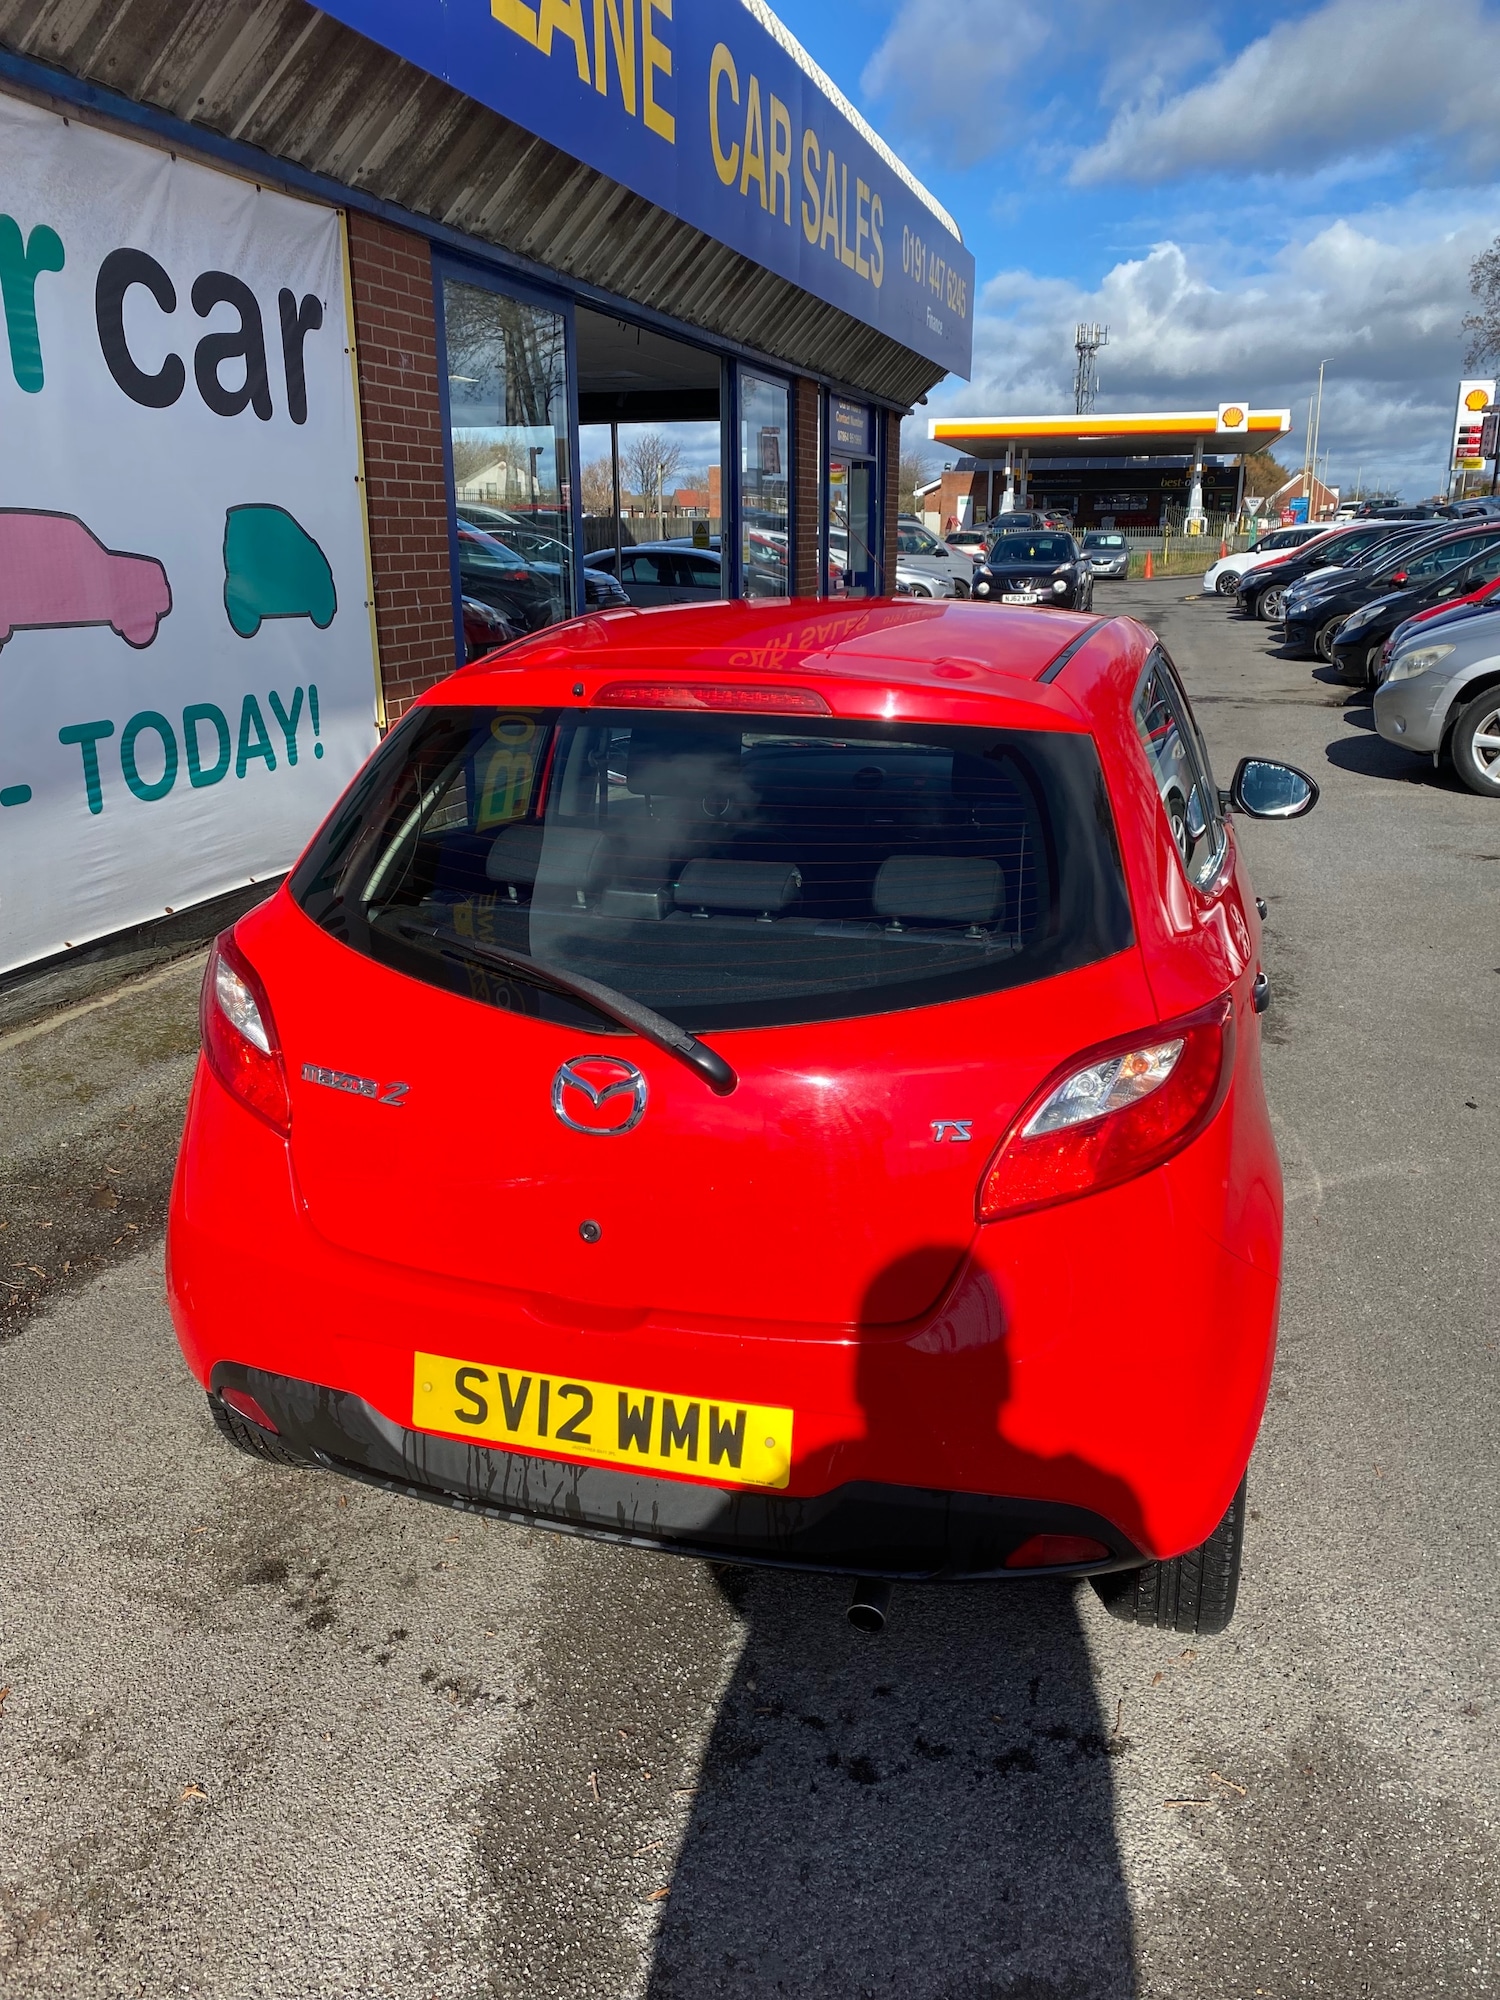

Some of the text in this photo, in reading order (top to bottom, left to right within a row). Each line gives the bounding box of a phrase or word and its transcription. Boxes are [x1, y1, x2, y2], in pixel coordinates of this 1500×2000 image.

[708, 41, 792, 227] CAR
[801, 127, 885, 289] SALES
[902, 224, 927, 288] 0191
[928, 251, 946, 301] 447
[946, 266, 967, 319] 6245
[95, 246, 324, 425] car
[926, 305, 943, 336] Finance
[1160, 477, 1204, 488] best-o
[58, 684, 325, 816] TODAY!
[378, 1080, 411, 1107] 2
[930, 1119, 973, 1142] TS
[454, 1366, 748, 1469] SV12 WMW
